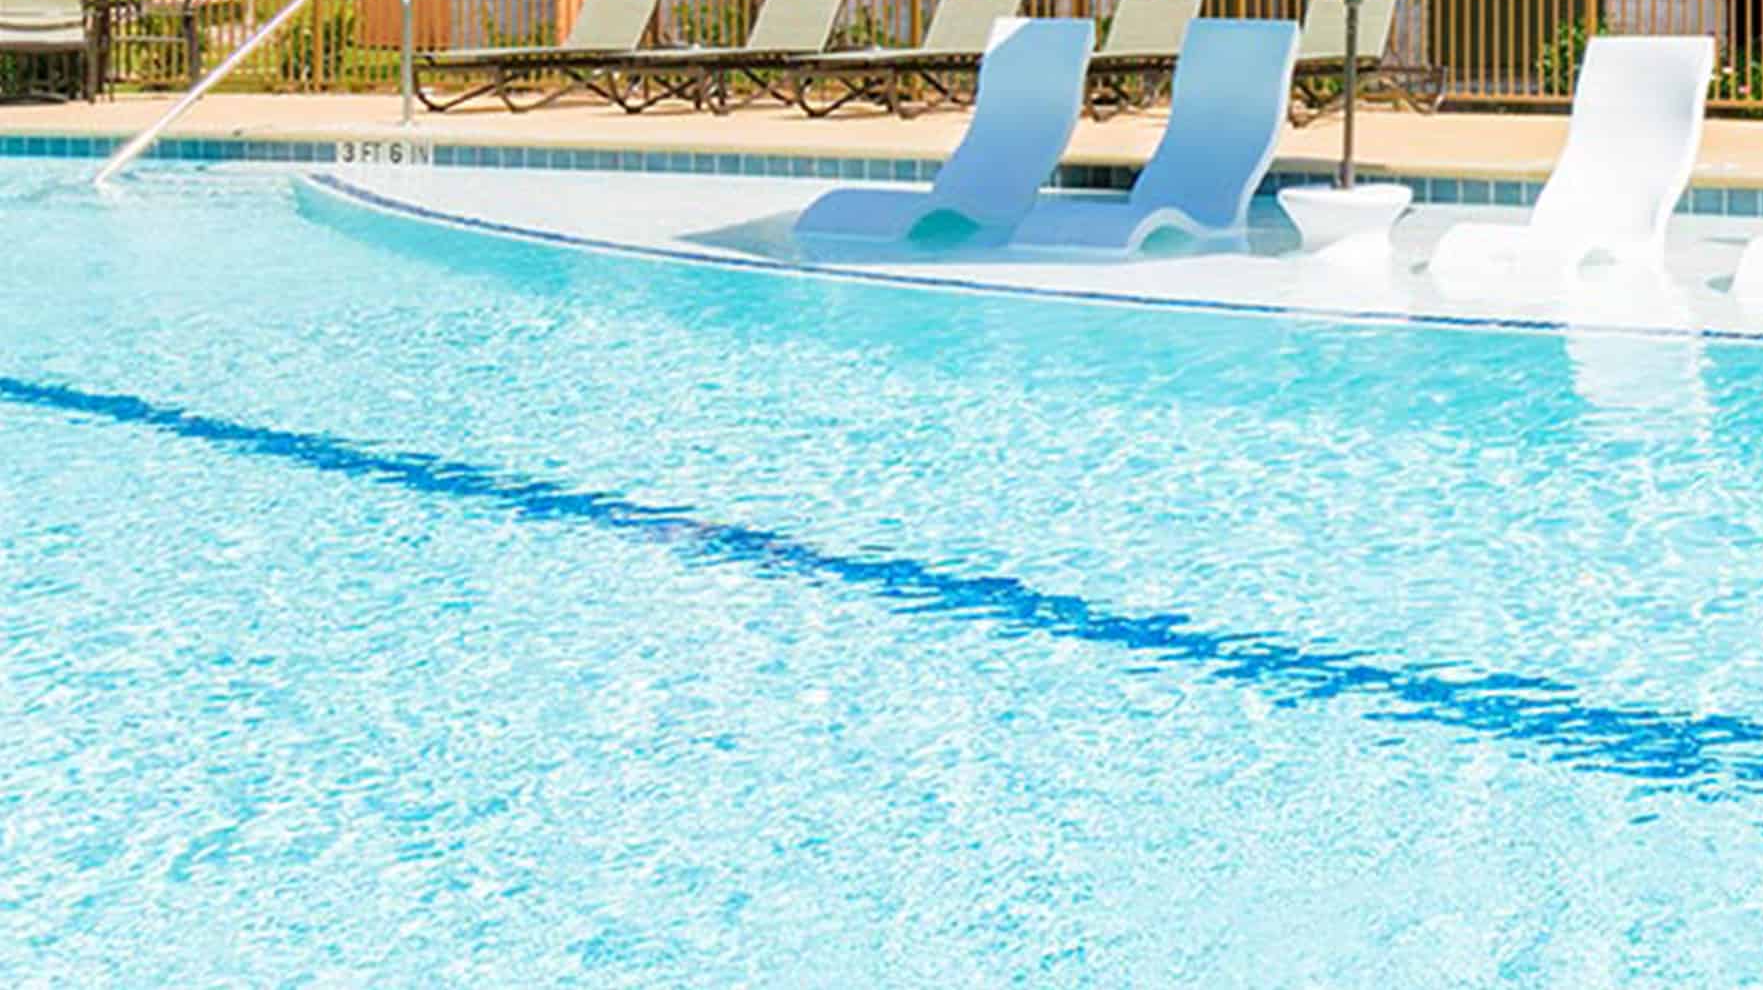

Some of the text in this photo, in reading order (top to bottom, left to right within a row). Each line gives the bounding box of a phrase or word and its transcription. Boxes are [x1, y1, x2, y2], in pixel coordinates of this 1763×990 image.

[342, 142, 430, 164] 3 FT 6 IN
